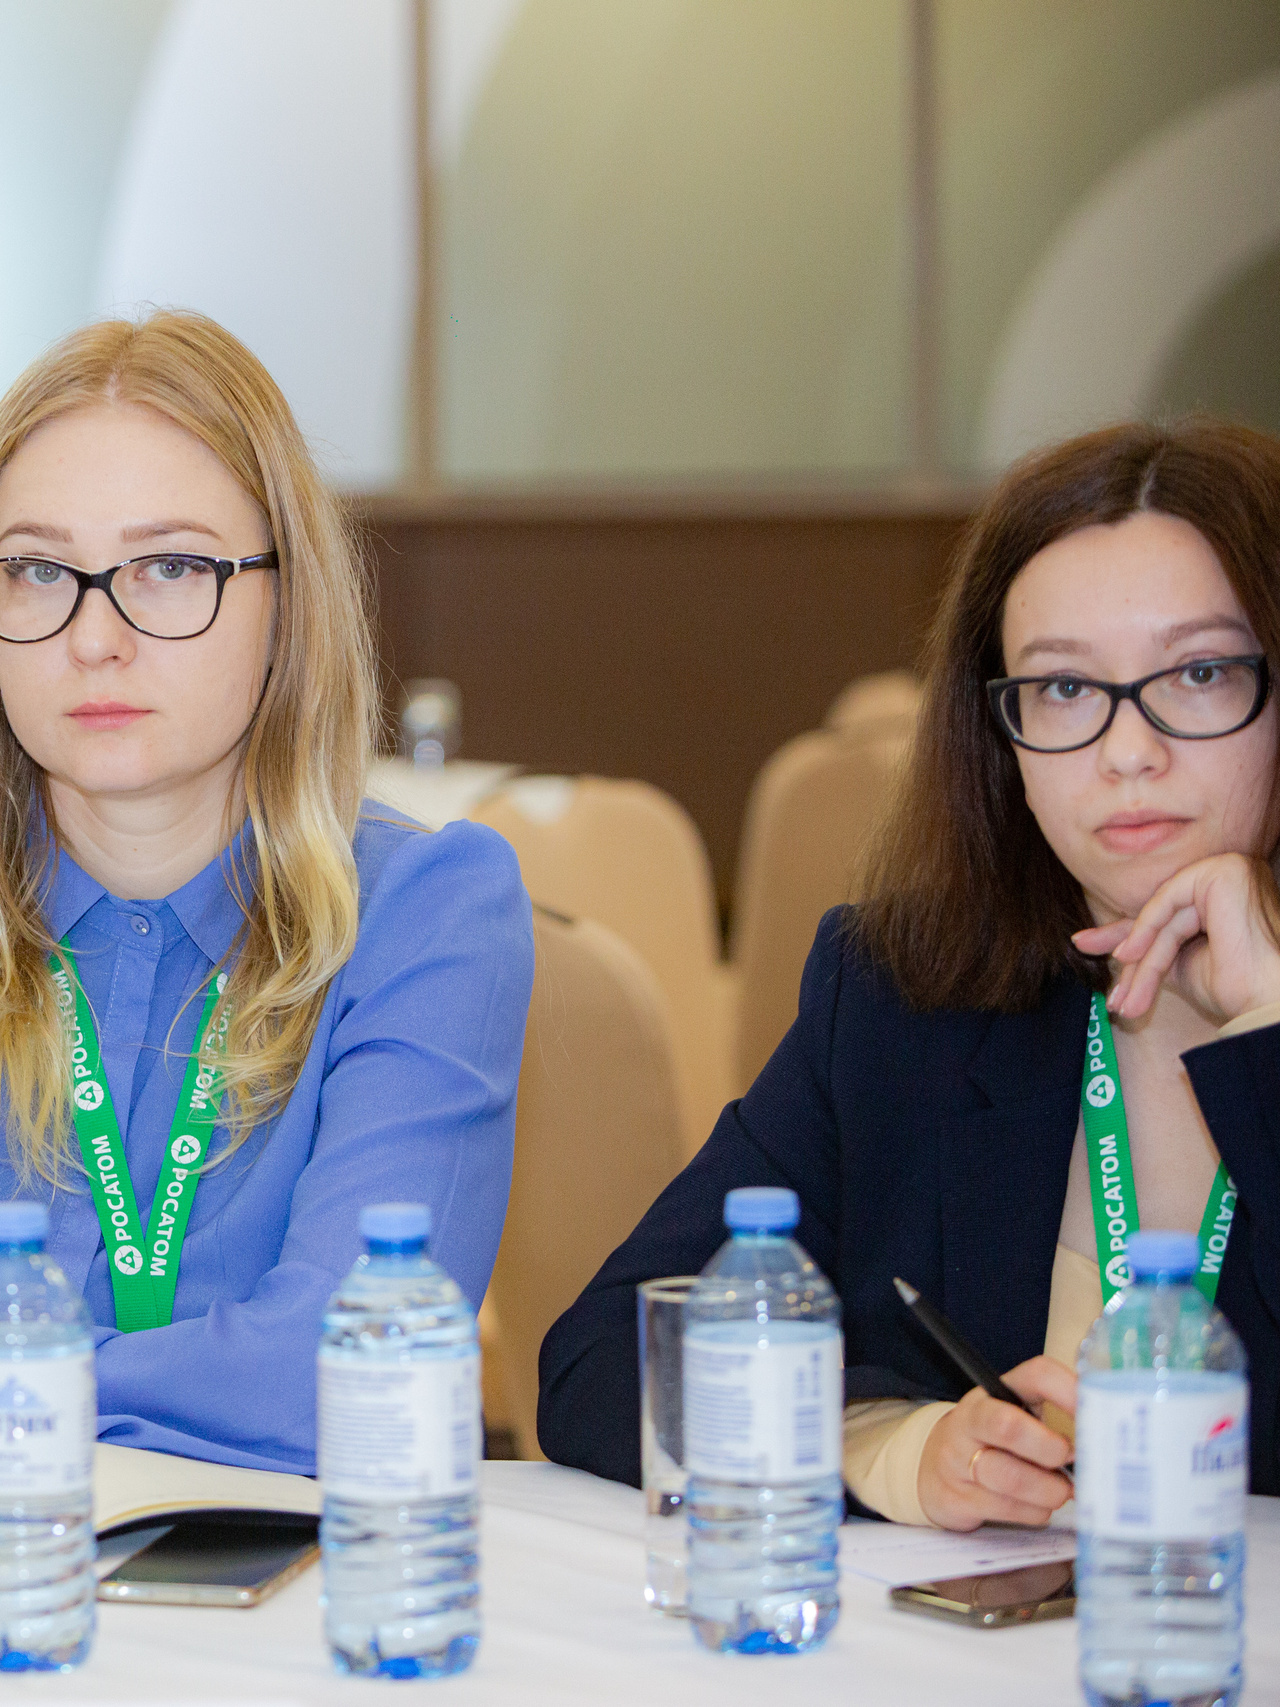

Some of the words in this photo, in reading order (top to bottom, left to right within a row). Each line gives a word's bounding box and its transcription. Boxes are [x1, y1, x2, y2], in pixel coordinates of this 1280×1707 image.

[91, 1134, 133, 1242] РОСАТОМ
[149, 1166, 190, 1277] РОСАТОМ
[1098, 1133, 1129, 1253] РОСАТОМ
